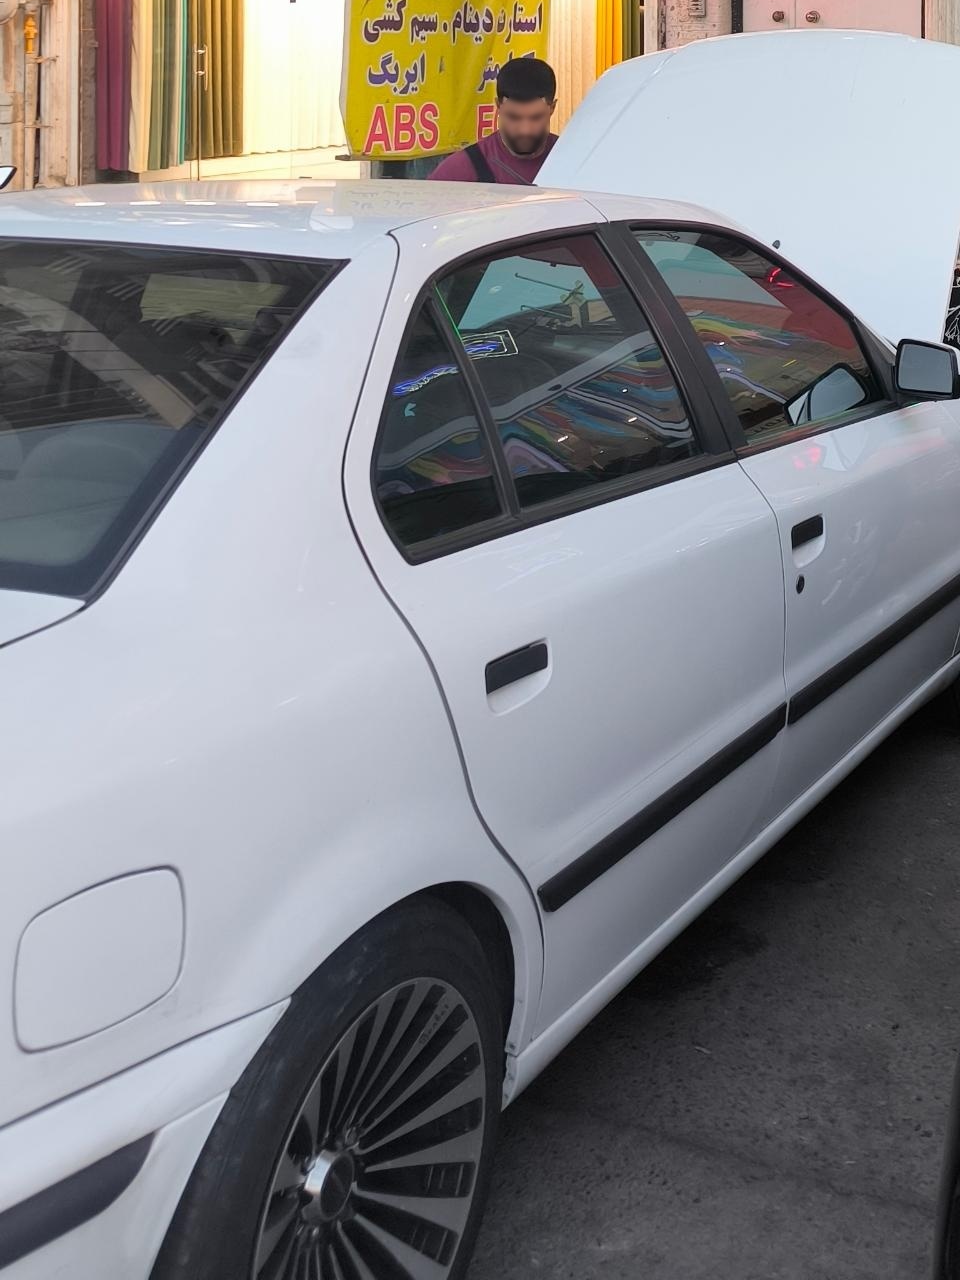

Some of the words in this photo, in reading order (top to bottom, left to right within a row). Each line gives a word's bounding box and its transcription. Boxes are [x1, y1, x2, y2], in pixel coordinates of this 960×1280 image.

[410, 11, 438, 44] سیم
[367, 52, 426, 95] ایربگ
[363, 102, 440, 154] ABS
